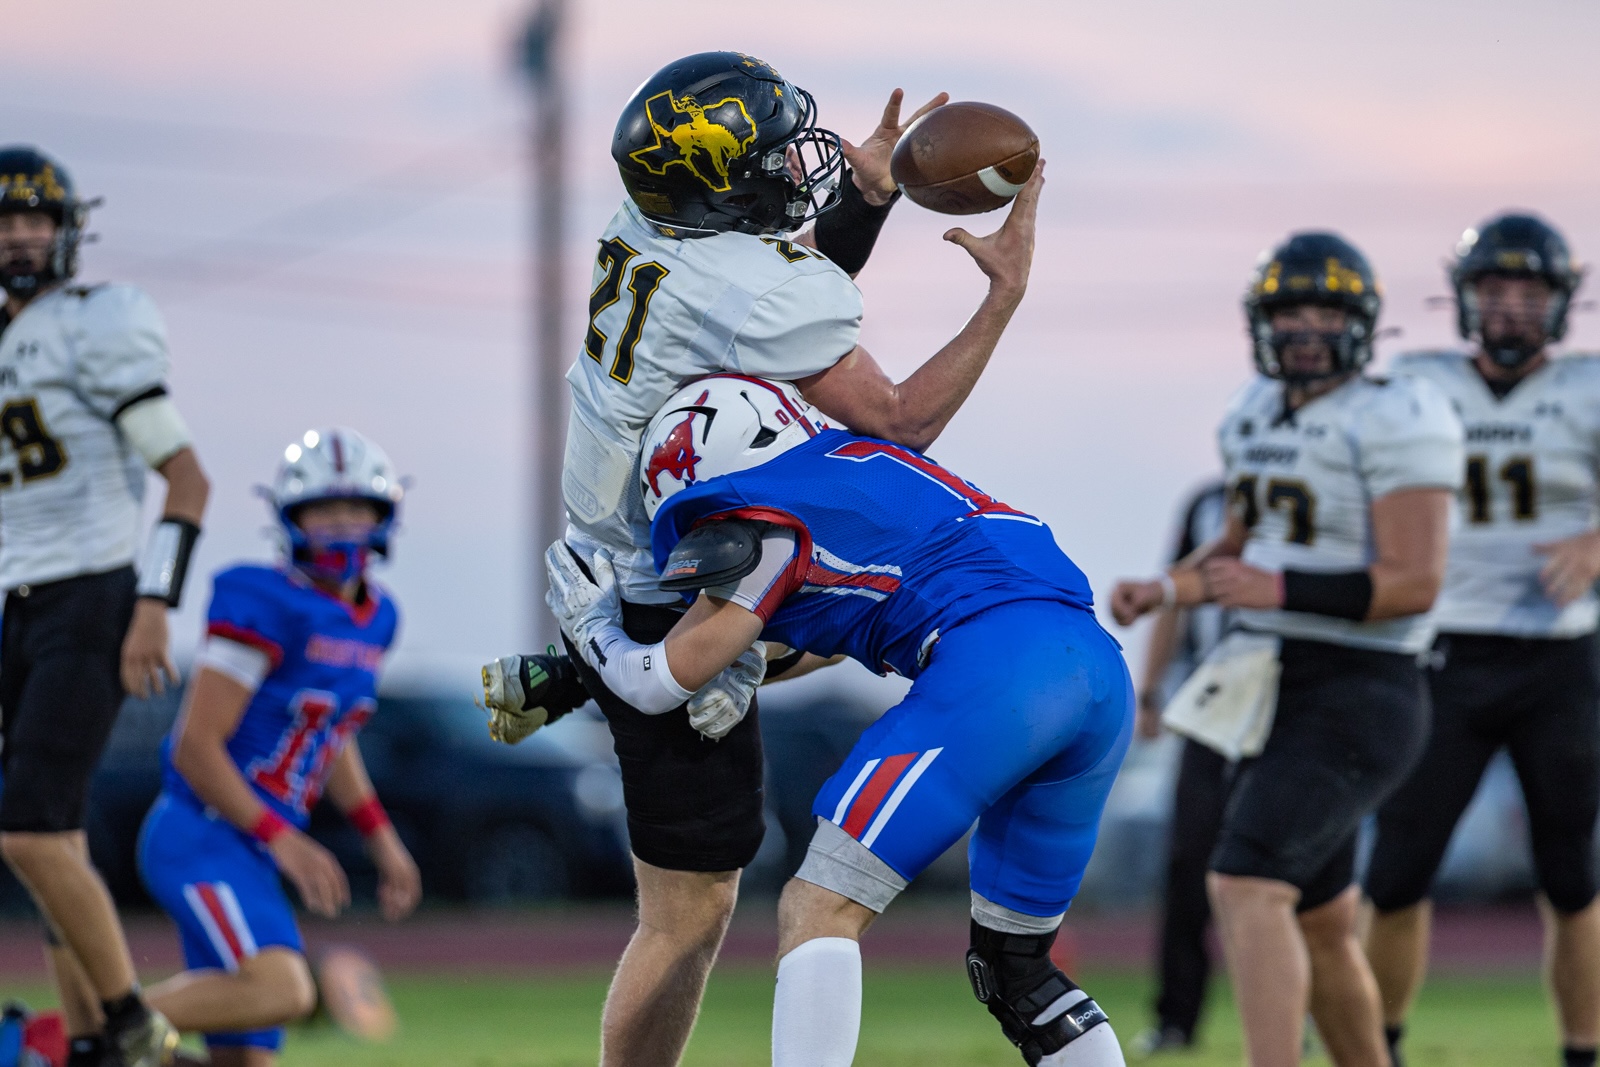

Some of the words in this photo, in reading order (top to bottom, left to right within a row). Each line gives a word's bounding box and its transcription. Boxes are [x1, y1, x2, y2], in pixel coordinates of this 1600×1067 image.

[759, 237, 828, 263] 2
[585, 236, 670, 386] 21
[0, 396, 69, 488] 9
